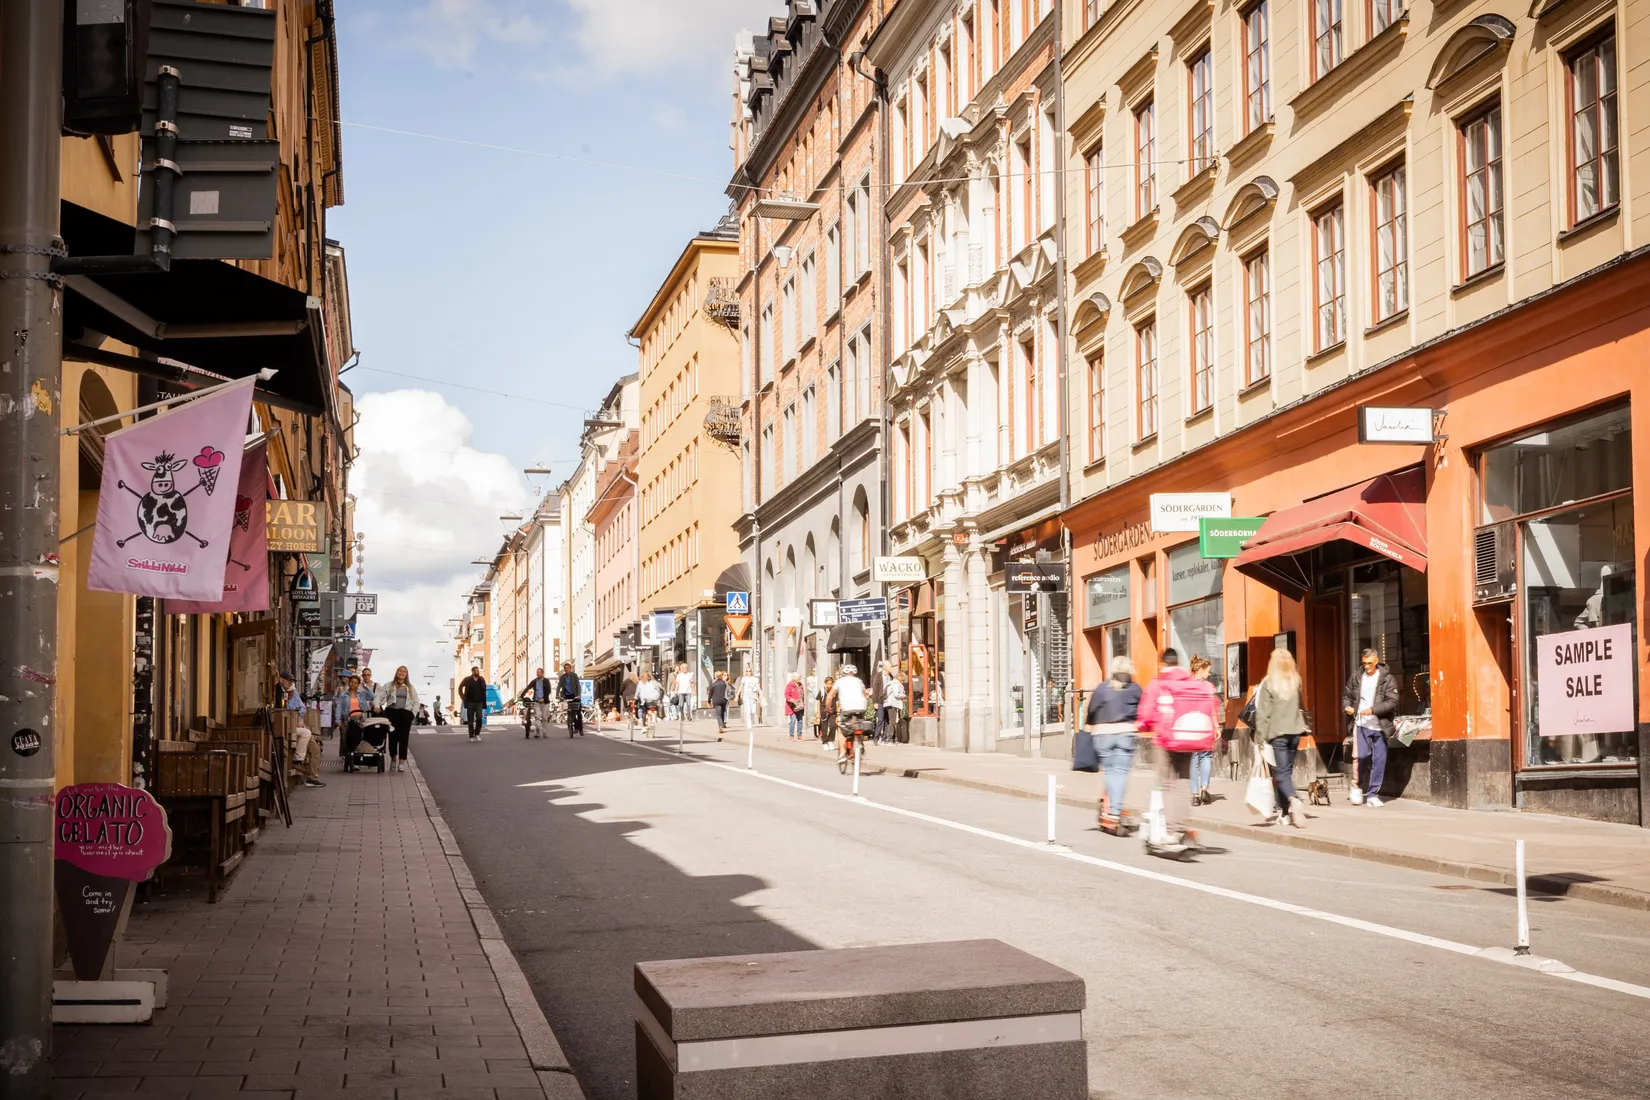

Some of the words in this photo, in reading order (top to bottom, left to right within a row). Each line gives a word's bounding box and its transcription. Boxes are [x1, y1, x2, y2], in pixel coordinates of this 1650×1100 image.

[1160, 502, 1223, 512] SÖDERGÅRDEN
[286, 542, 316, 551] HORSE
[878, 561, 922, 572] WACKO
[1555, 638, 1612, 666] SAMPLE
[1566, 674, 1602, 698] SALE
[58, 793, 148, 819] ORGANIC
[59, 820, 144, 846] GELATO
[82, 885, 103, 898] Come
[100, 897, 113, 908] try
